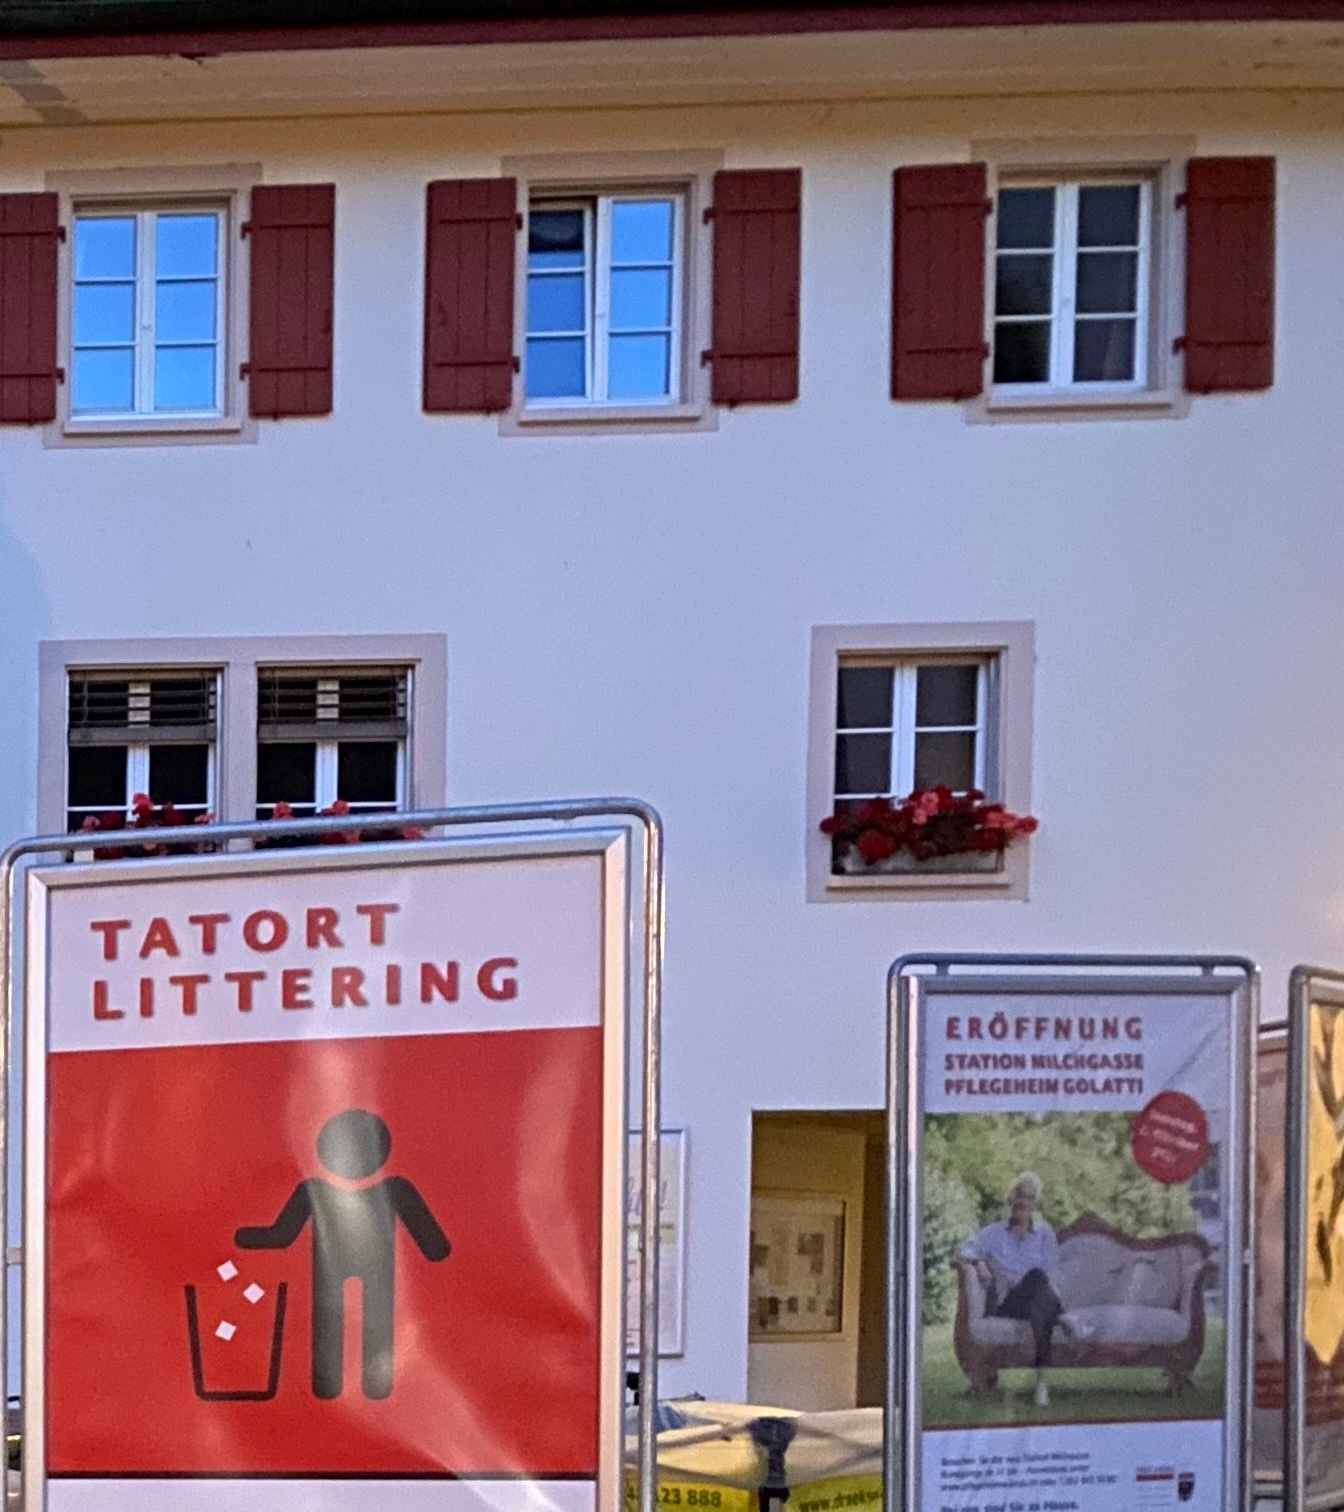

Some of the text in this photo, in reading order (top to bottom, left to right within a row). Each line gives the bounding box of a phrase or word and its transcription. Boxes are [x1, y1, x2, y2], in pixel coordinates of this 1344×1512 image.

[91, 903, 400, 961] TATORT
[92, 957, 519, 1021] LITTERING
[945, 1011, 1143, 1041] ERÖFFNUNG
[944, 1052, 1144, 1071] STATION MILCHGASSE
[1063, 1076, 1144, 1095] GOLATTI
[687, 1488, 722, 1508] 888
